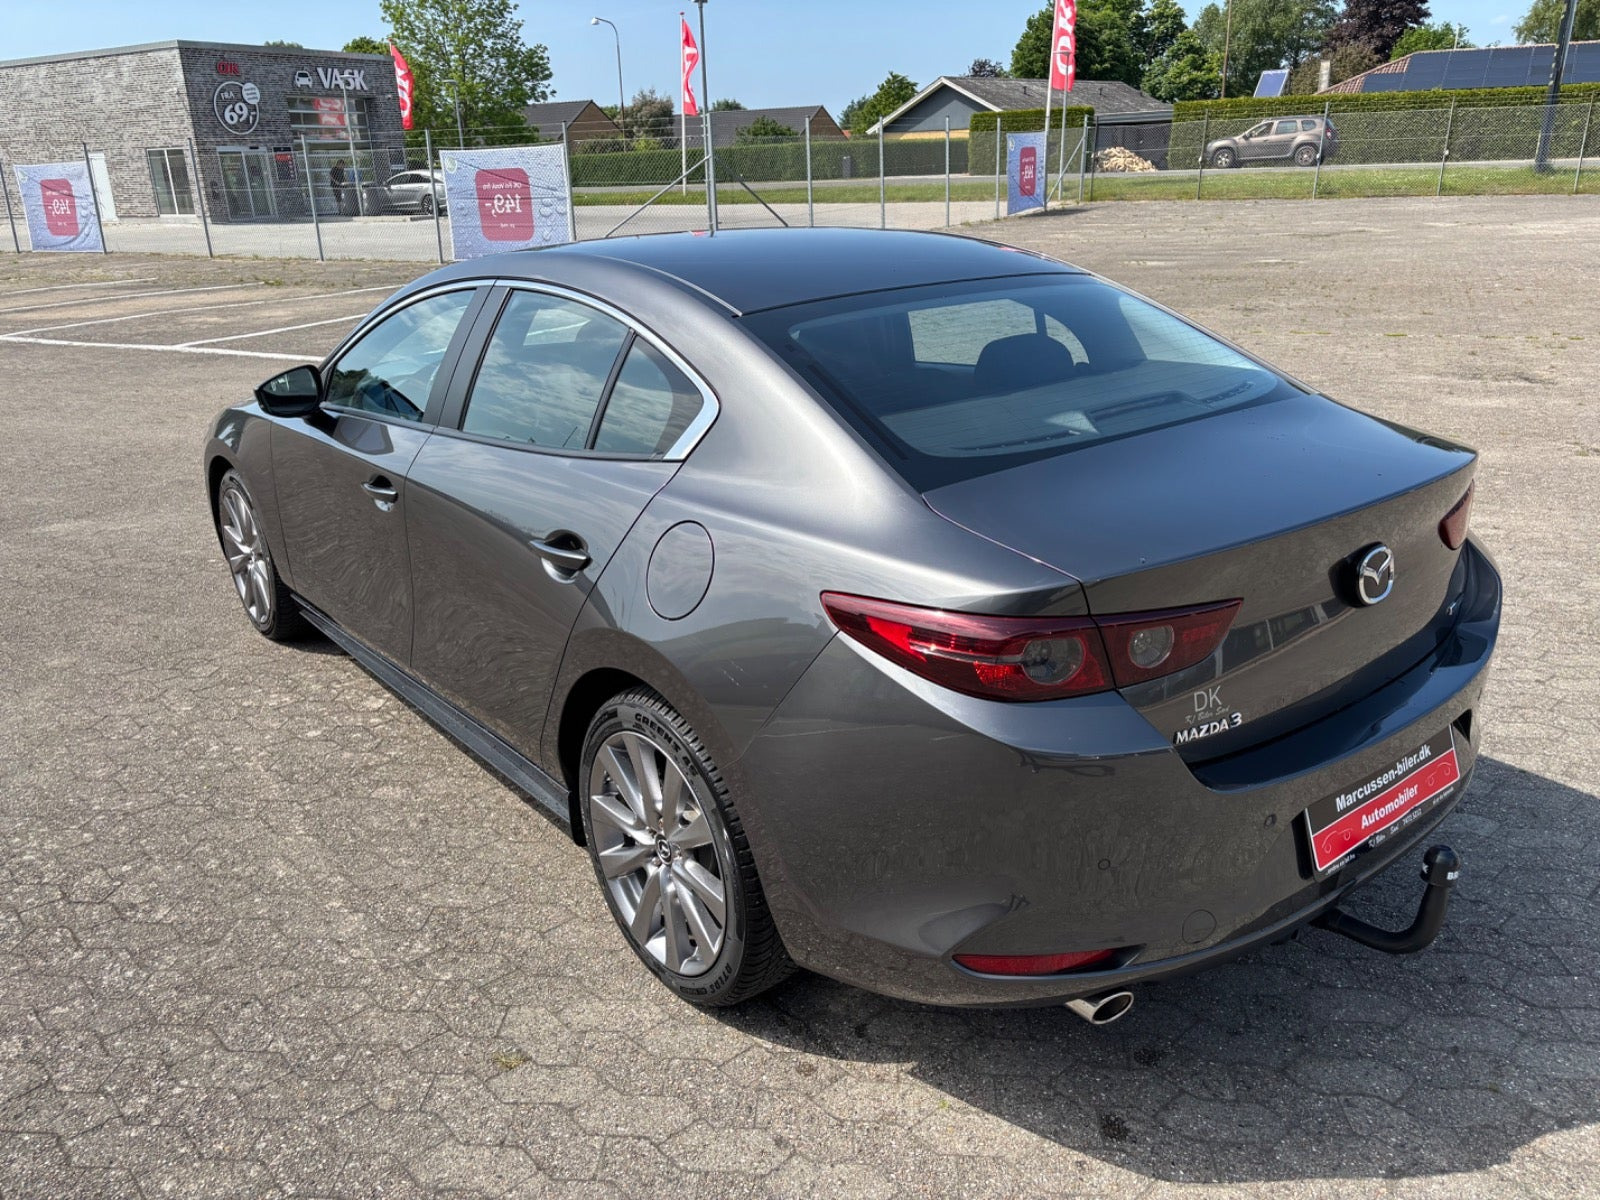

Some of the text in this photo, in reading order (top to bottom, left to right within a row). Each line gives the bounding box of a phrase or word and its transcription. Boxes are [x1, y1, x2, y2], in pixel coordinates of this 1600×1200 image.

[217, 61, 240, 75] OK
[316, 66, 368, 91] VASK
[220, 90, 235, 100] FRA
[224, 101, 256, 125] 69,-
[1193, 685, 1222, 712] DK
[1335, 744, 1432, 812] Marcussen-biler.dk
[1361, 783, 1419, 829] Automobiler
